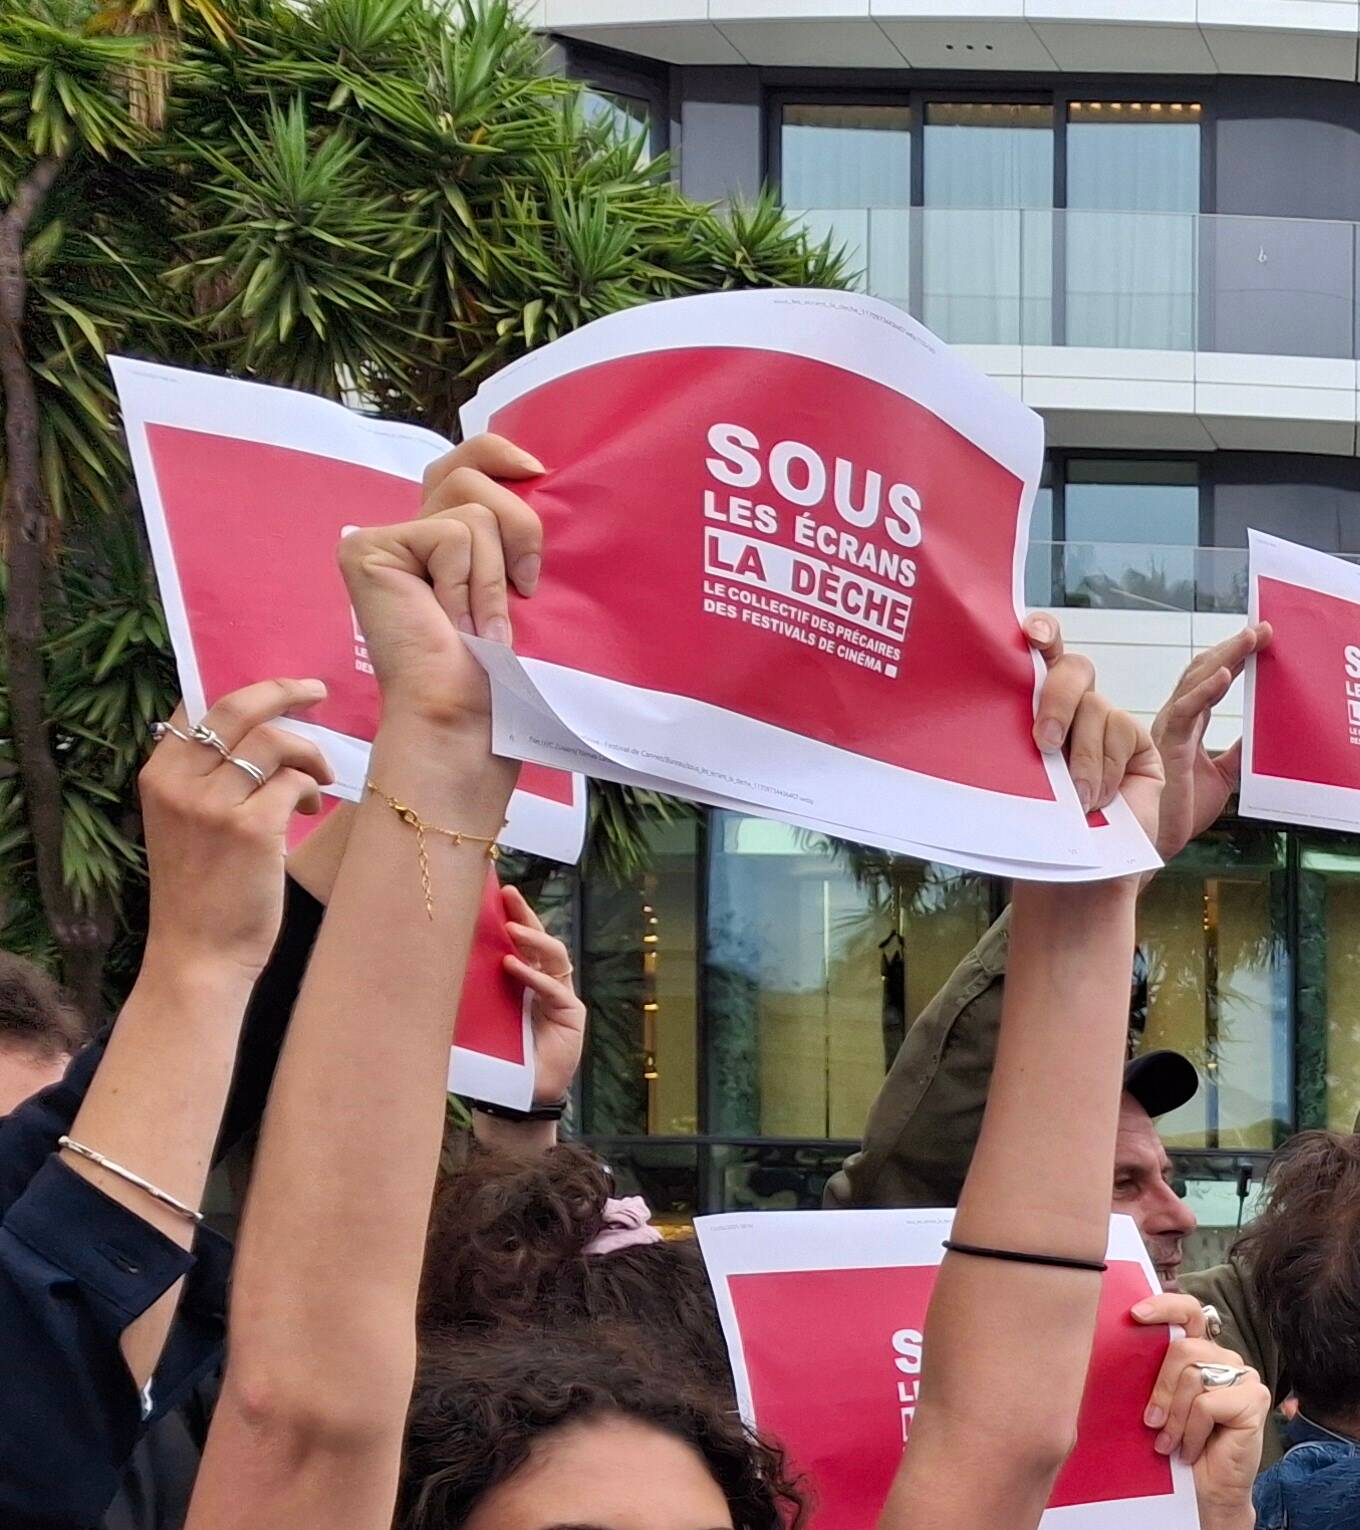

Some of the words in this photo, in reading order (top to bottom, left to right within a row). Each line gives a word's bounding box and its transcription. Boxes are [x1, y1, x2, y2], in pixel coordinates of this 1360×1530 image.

[705, 423, 922, 548] SOUS
[704, 490, 778, 534] LES
[795, 512, 917, 587] ÉCRANS
[708, 535, 767, 582] LA
[790, 558, 909, 637] DÈCHE
[704, 581, 726, 597] LE
[728, 587, 810, 624] COLLECTIF
[811, 614, 835, 635] DES
[836, 628, 901, 661] PRÉCAIRES
[704, 599, 737, 618] DES
[742, 609, 816, 646] FESTIVALS
[818, 638, 835, 654] DE
[837, 645, 882, 672] CINÉMA
